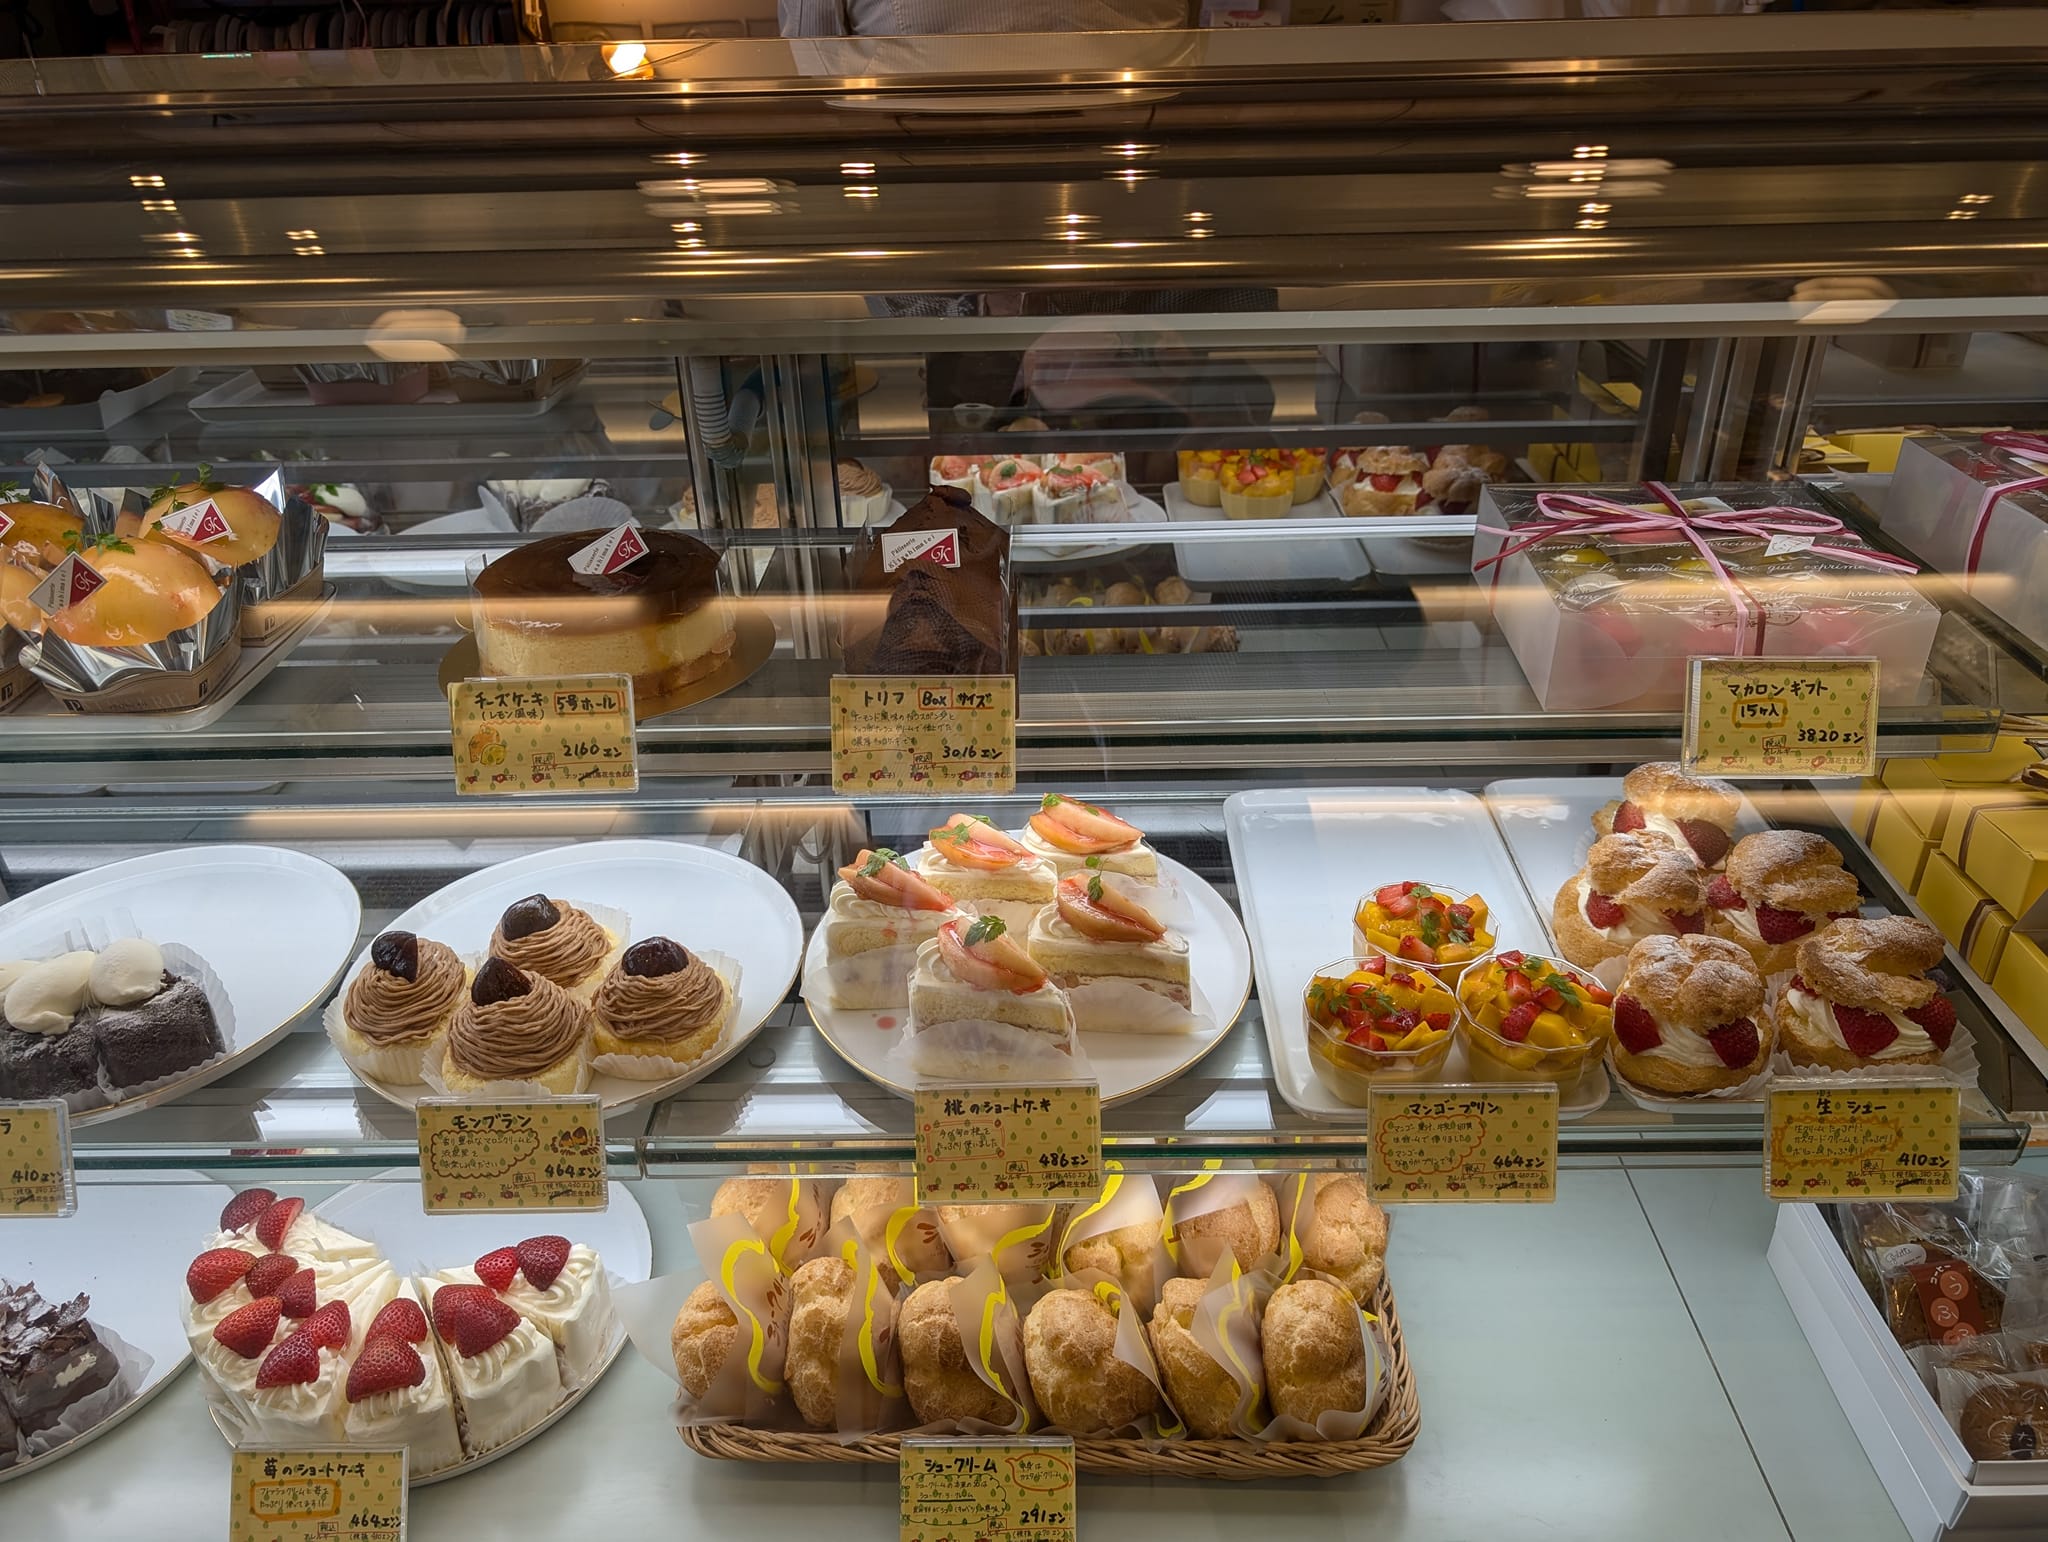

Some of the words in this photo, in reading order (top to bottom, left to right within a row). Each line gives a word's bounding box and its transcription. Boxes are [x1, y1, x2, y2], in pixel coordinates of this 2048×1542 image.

[474, 692, 544, 709] チーズケーキ
[556, 694, 617, 711] 5号ホール
[865, 690, 904, 707] トリフ
[922, 691, 947, 706] Box
[957, 692, 992, 708] サイズ
[1409, 1099, 1499, 1115] マンゴープリン
[453, 1113, 531, 1129] モンブラン
[924, 1457, 997, 1473] シュークリーム
